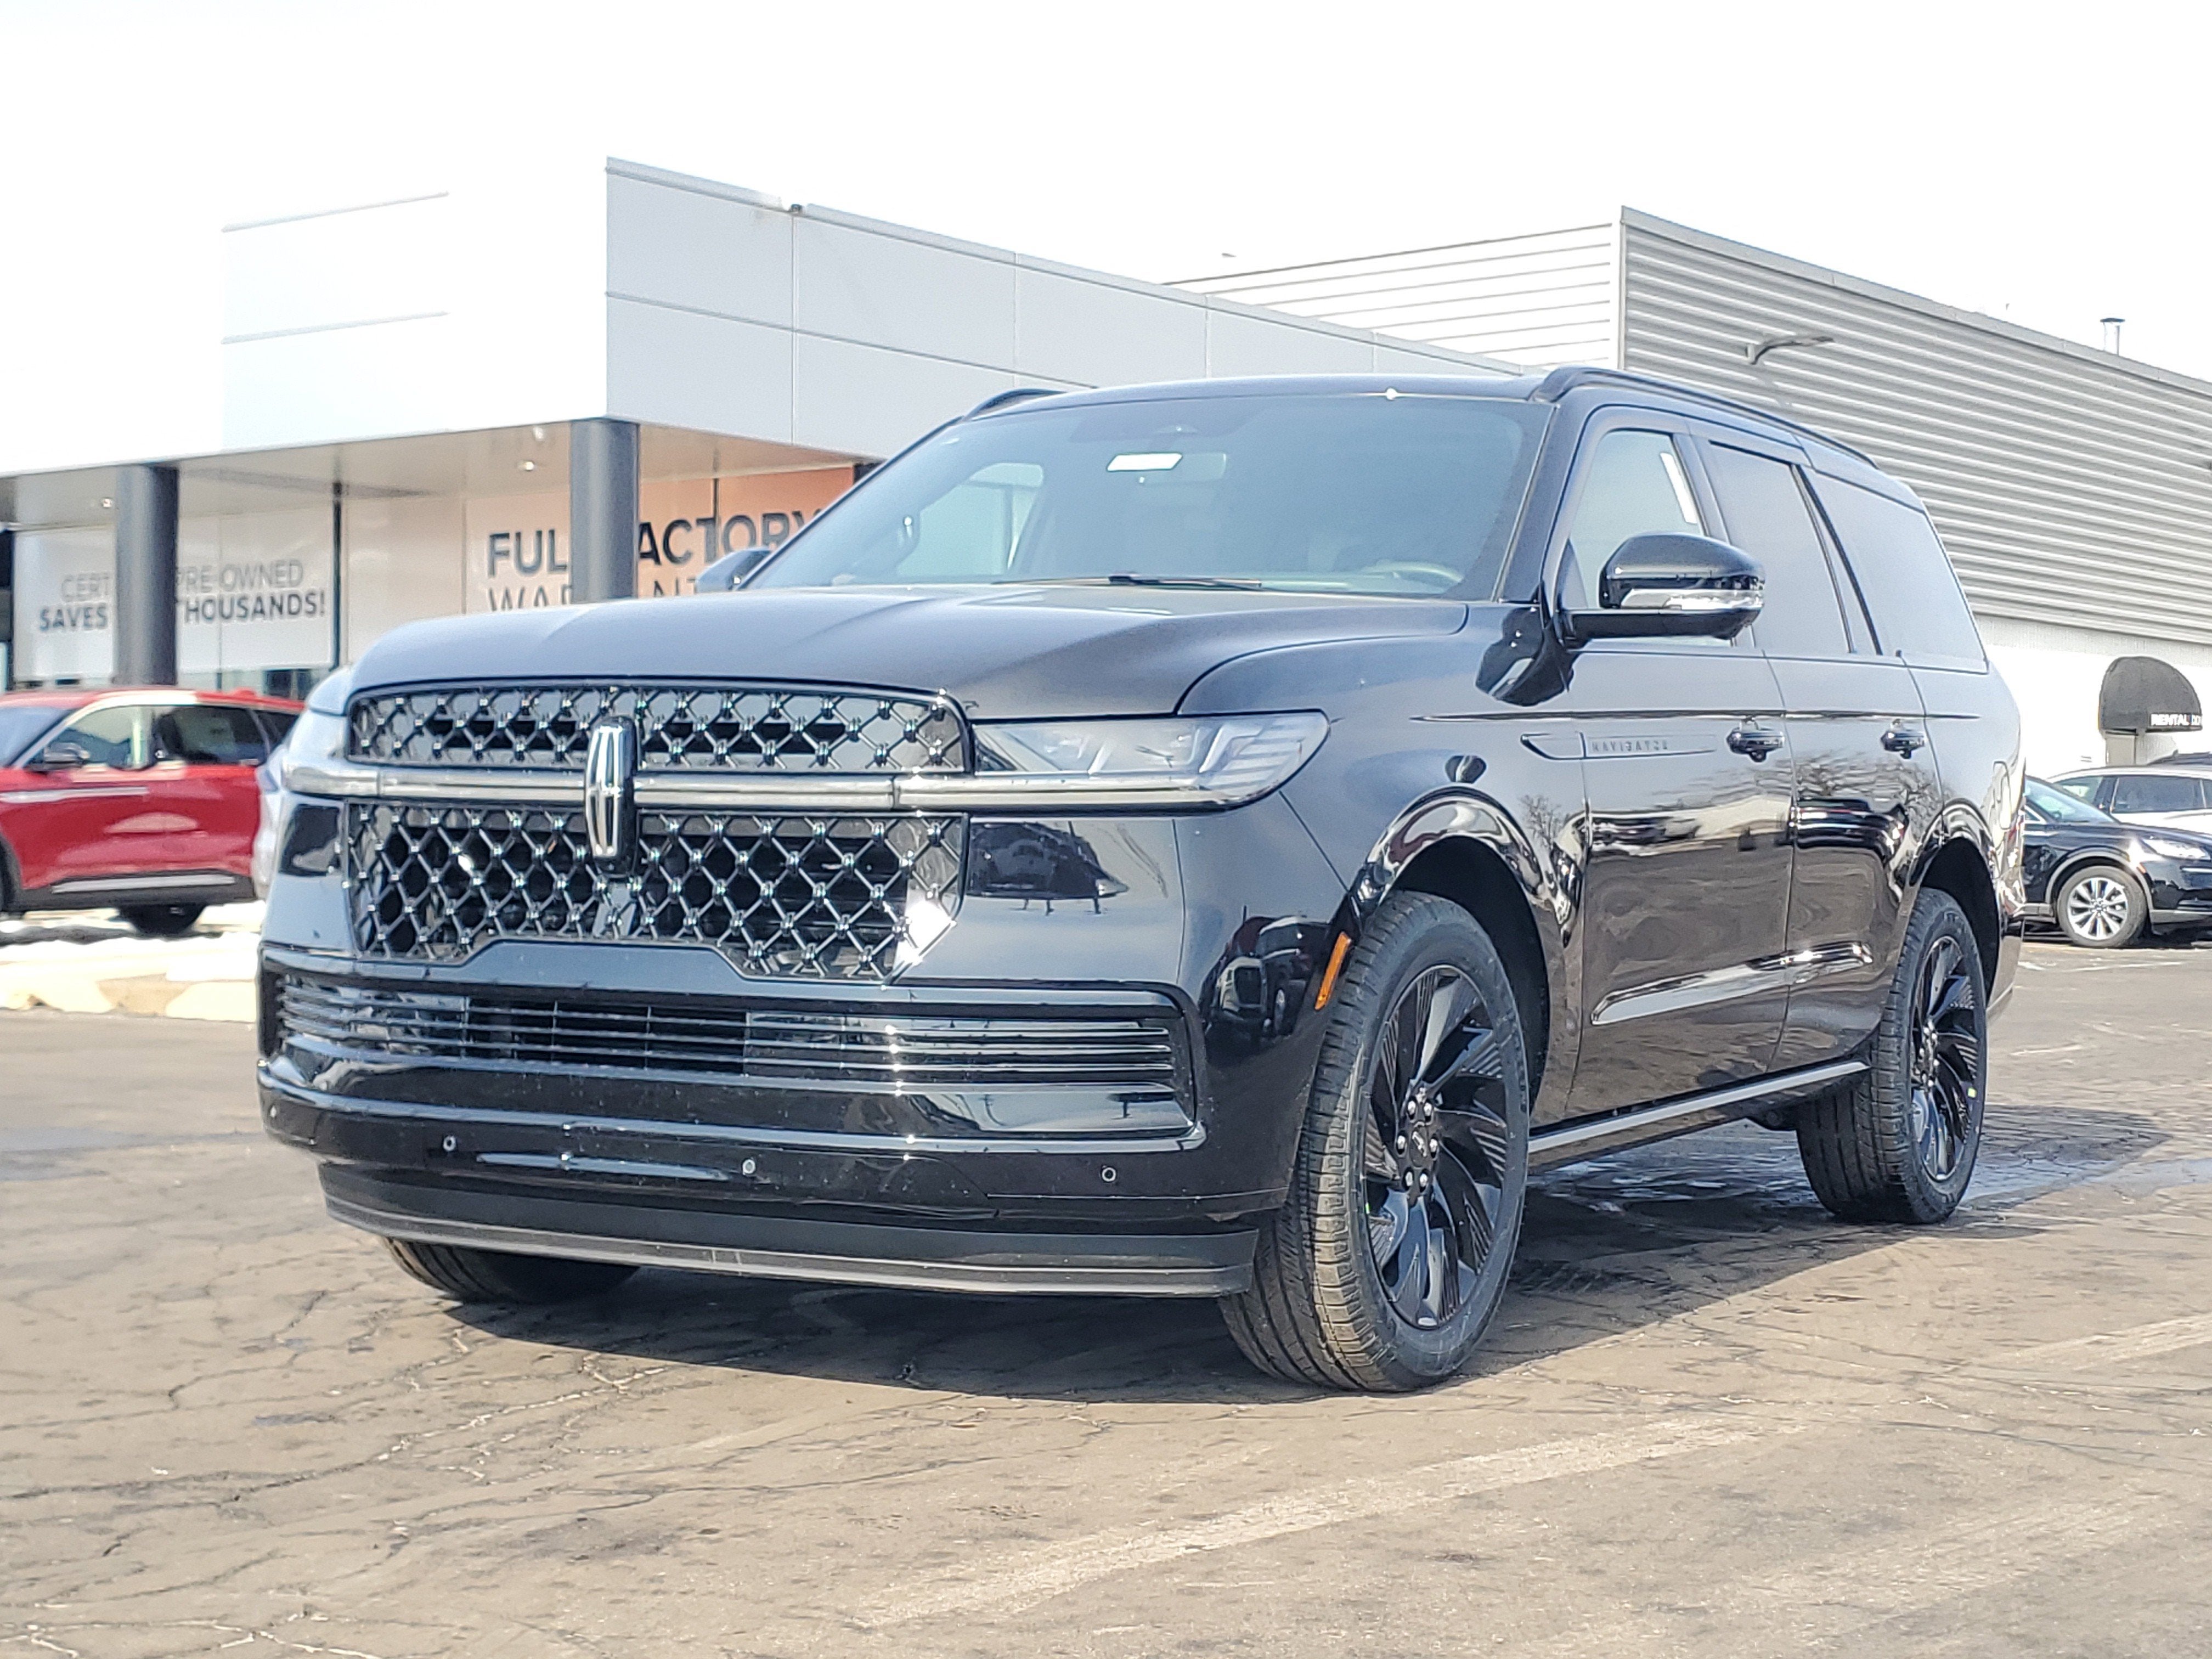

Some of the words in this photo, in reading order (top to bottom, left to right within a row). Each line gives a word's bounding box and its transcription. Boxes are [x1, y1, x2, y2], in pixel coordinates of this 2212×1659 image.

[487, 529, 568, 578] FUL
[220, 560, 304, 592] OWNED
[40, 603, 108, 631] SAVES
[2151, 714, 2190, 726] RENTAL
